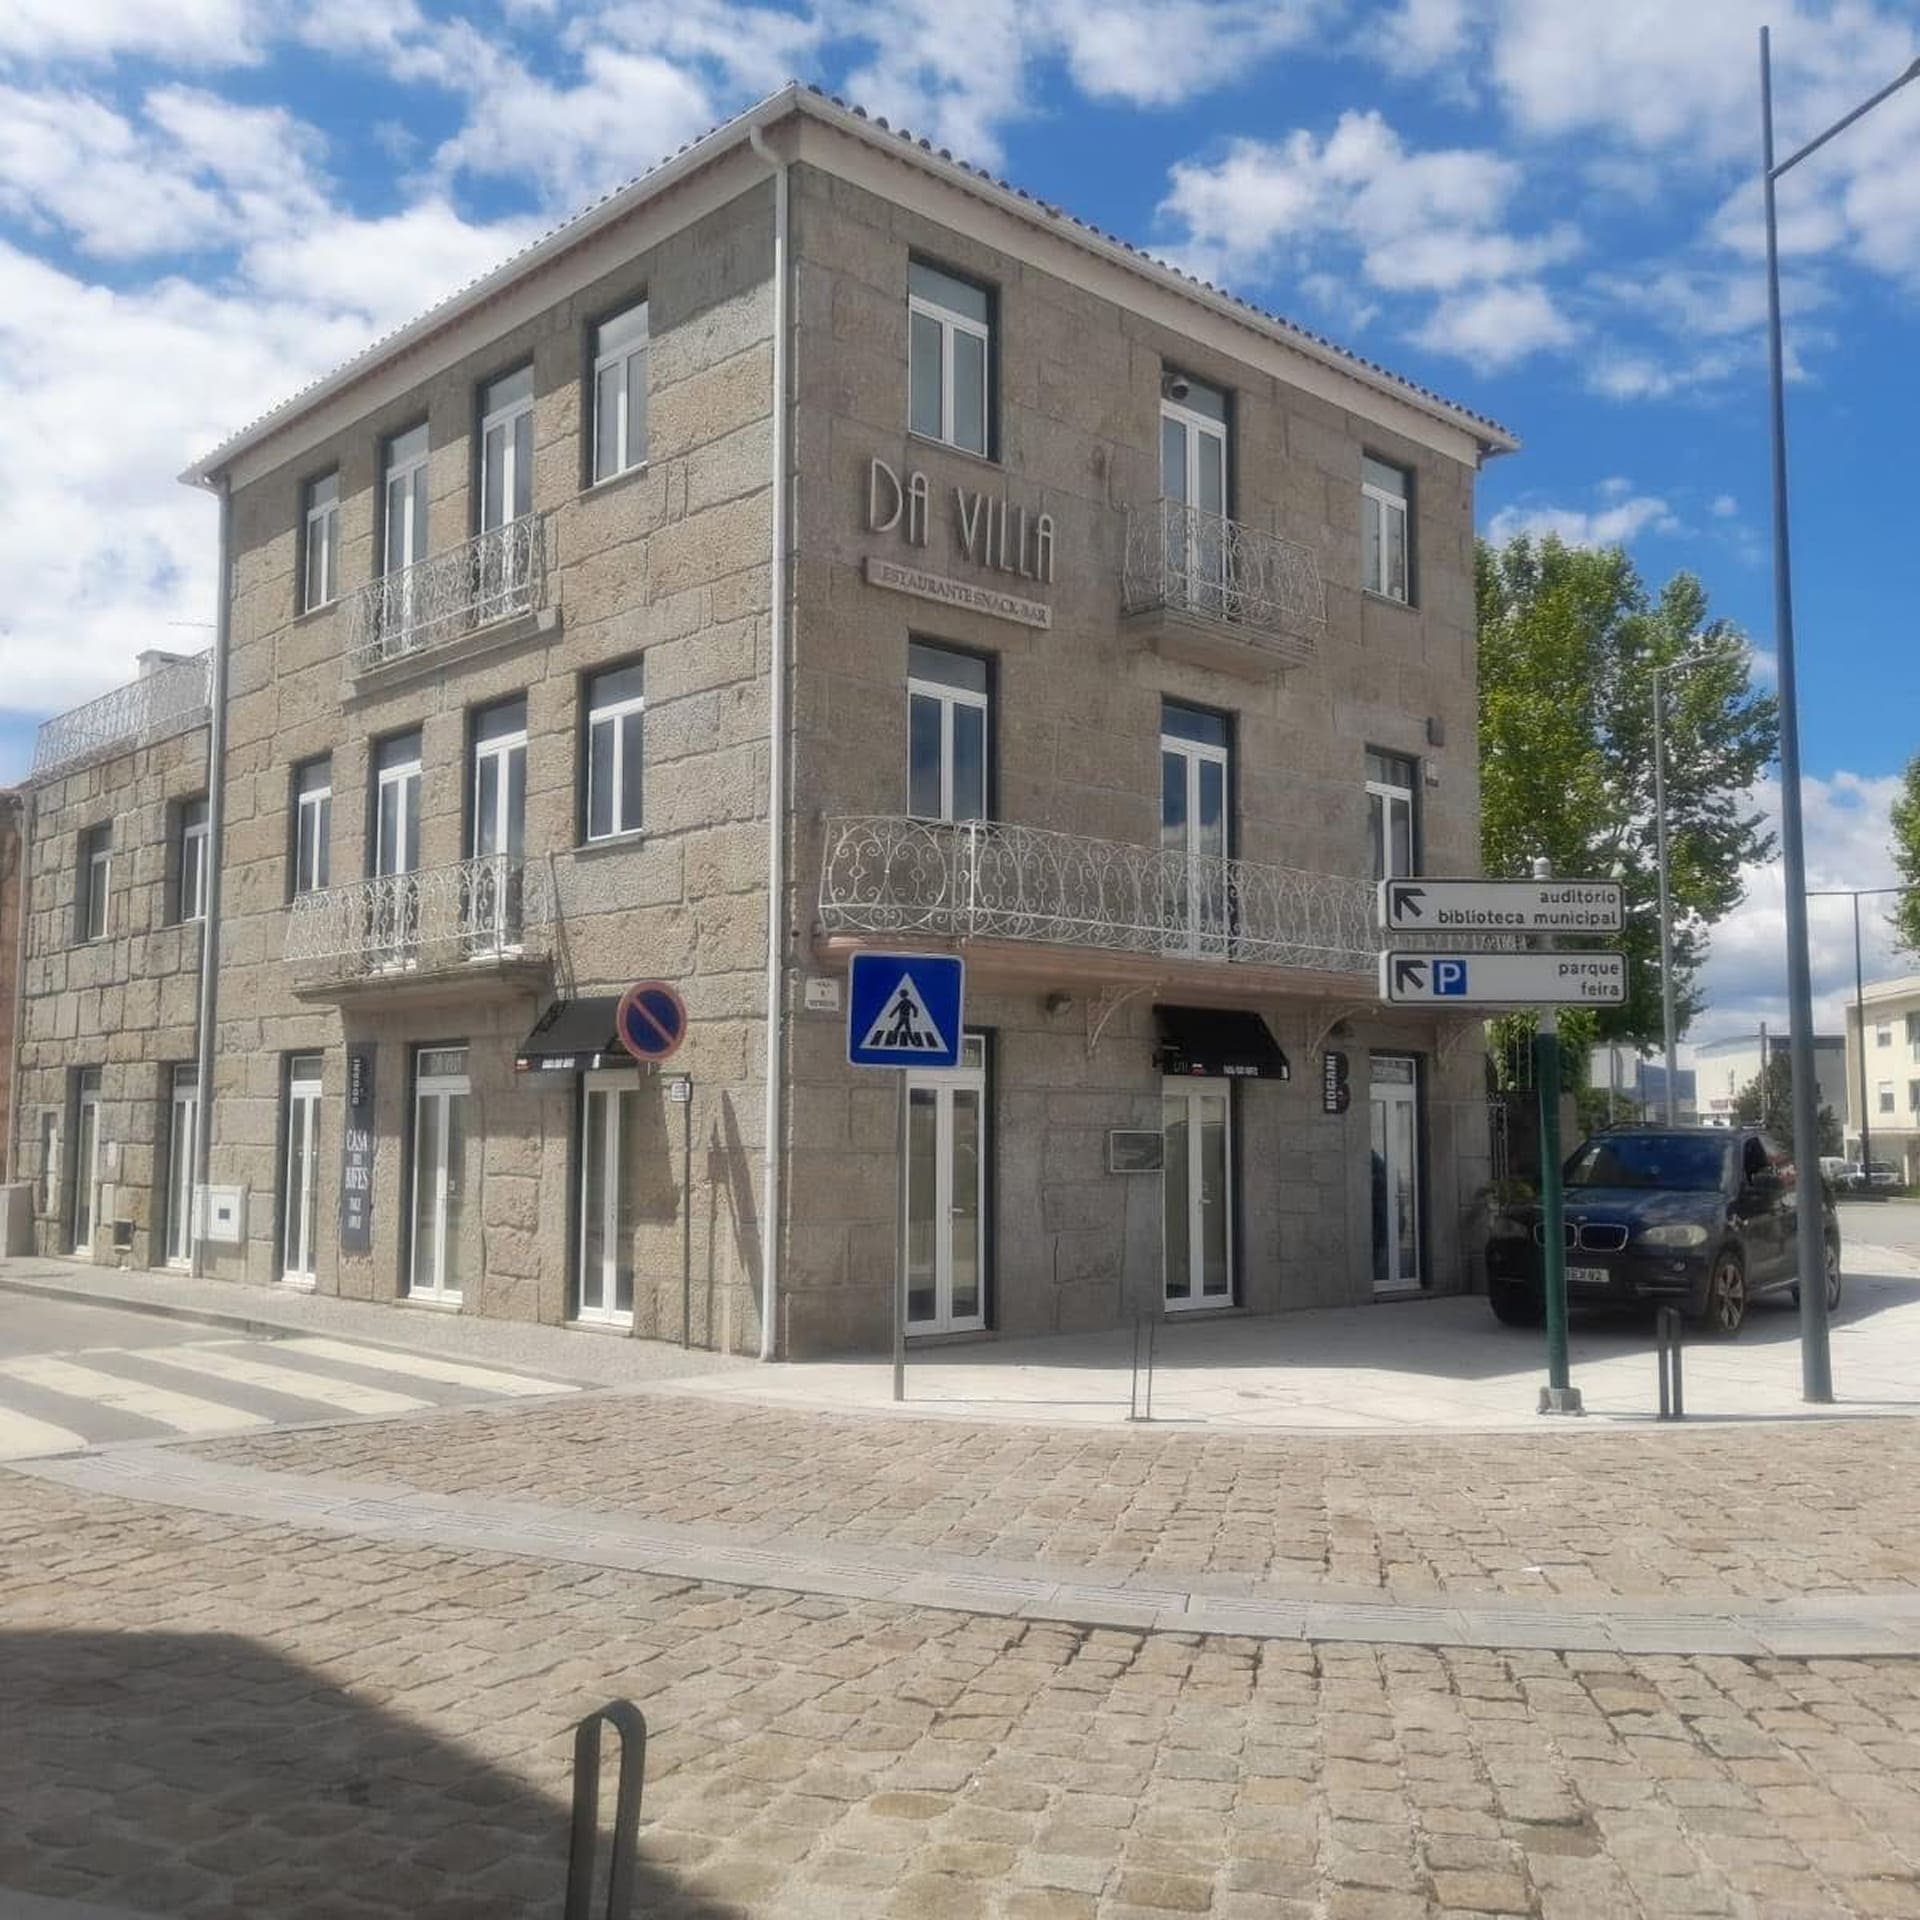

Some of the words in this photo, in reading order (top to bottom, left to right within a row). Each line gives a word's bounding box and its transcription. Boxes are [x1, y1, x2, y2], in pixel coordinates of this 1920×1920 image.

[870, 458, 929, 547] DA
[957, 486, 1054, 584] VILLA
[1022, 604, 1047, 623] BAR
[1539, 888, 1617, 904] auditório
[1438, 909, 1525, 925] biblioteca
[1533, 911, 1617, 927] municipal
[1438, 962, 1461, 993] P
[1558, 962, 1620, 976] parque
[1580, 982, 1620, 996] feira
[346, 1129, 368, 1152] CASA
